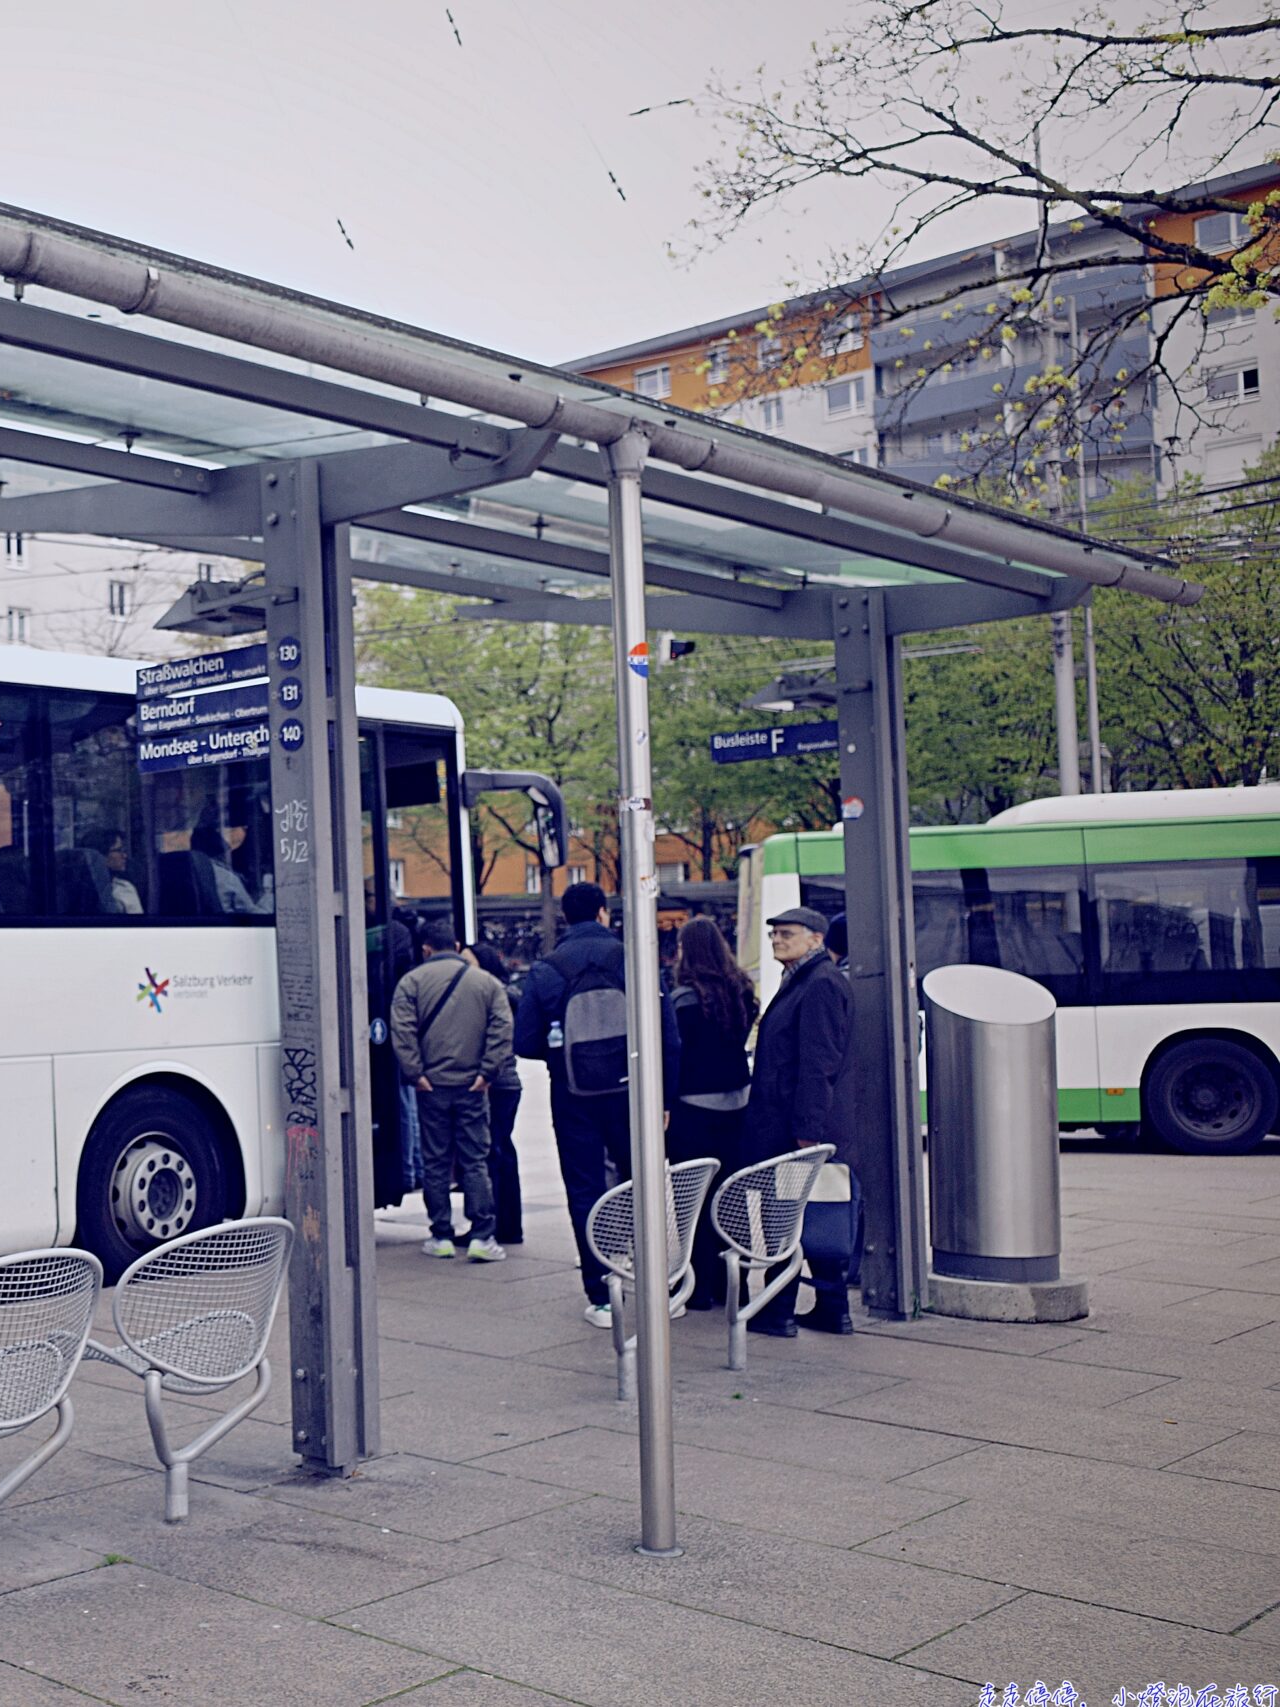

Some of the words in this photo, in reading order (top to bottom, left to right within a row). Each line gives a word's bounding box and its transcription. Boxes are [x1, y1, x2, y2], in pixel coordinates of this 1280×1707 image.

[279, 645, 298, 661] 130
[139, 657, 224, 686] Straßwalchen
[282, 686, 298, 701] 131
[141, 697, 195, 721] Berndorf
[140, 738, 198, 761] Mondsee
[209, 724, 270, 750] Unterach
[282, 726, 300, 741] 140
[713, 731, 768, 749] Busleiste
[770, 728, 785, 754] F
[172, 975, 215, 989] Salzburg
[216, 974, 254, 986] Verkehr
